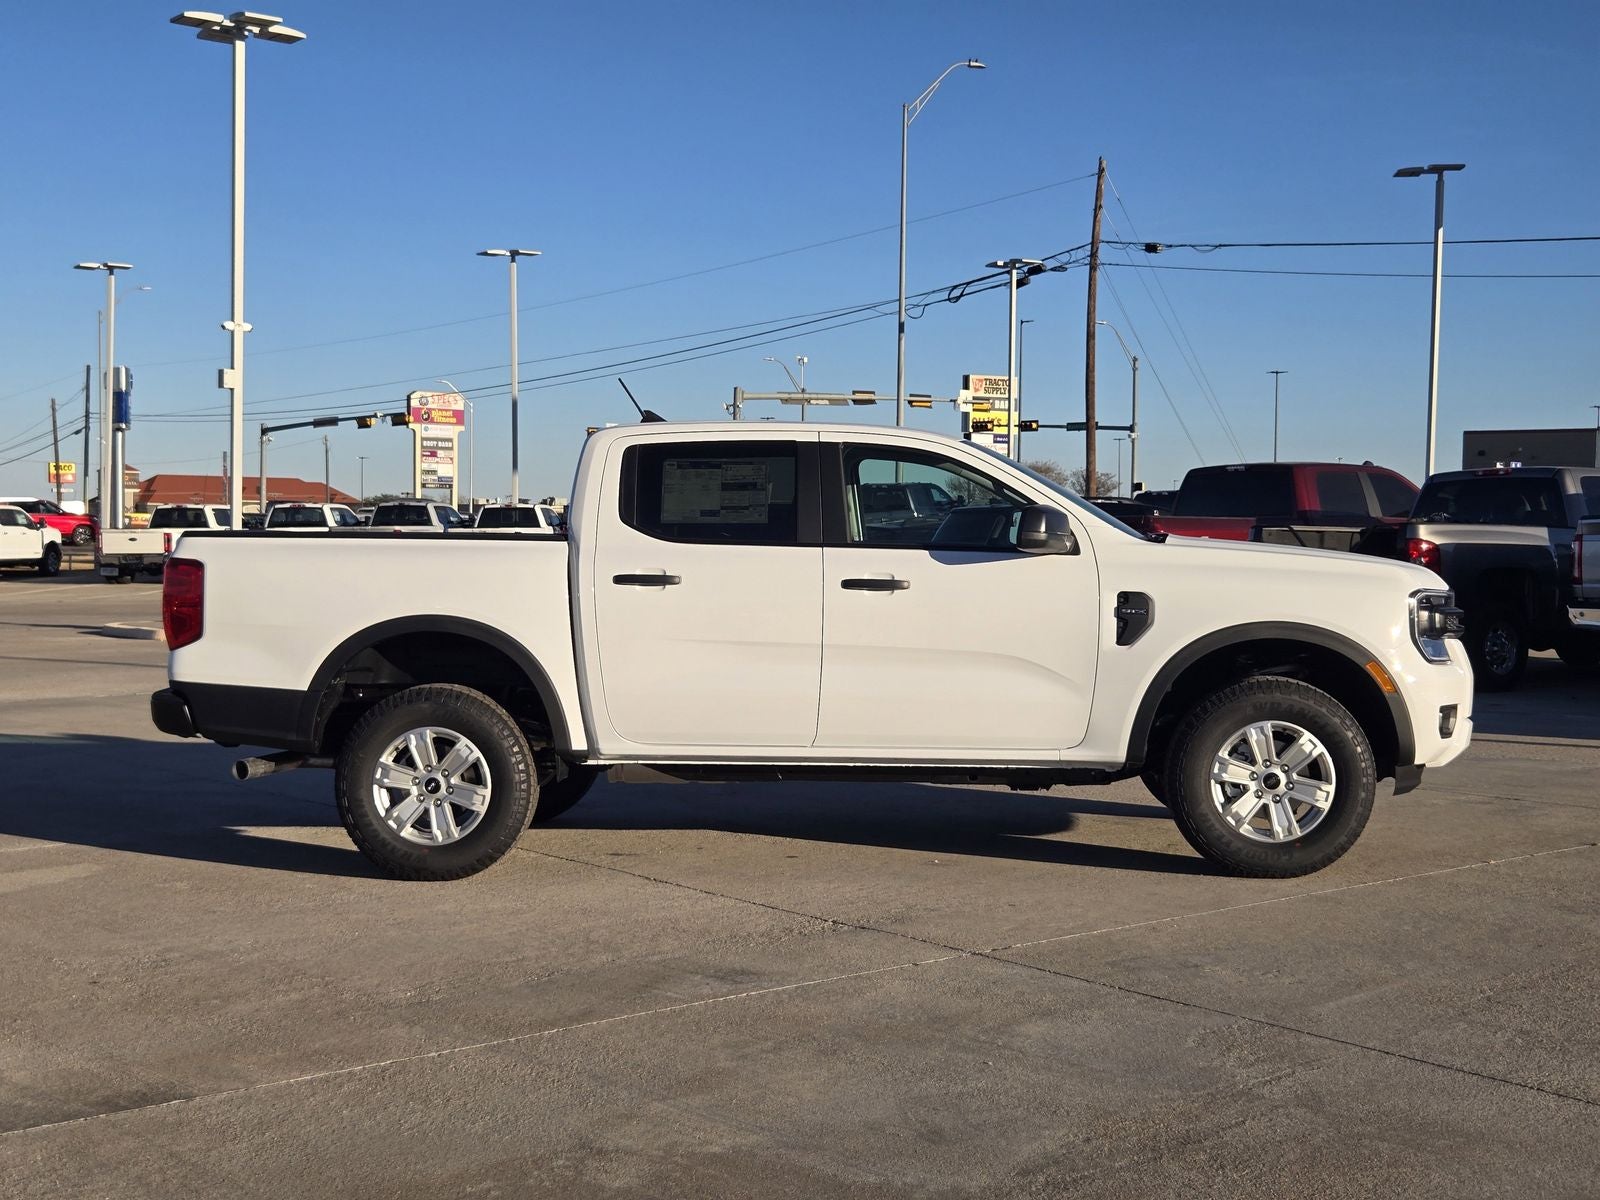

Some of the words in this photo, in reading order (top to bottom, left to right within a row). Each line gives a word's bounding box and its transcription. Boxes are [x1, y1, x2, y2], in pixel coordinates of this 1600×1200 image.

[984, 378, 1009, 387] TRACTO
[984, 386, 1007, 395] SUPPLY
[431, 409, 453, 418] planet
